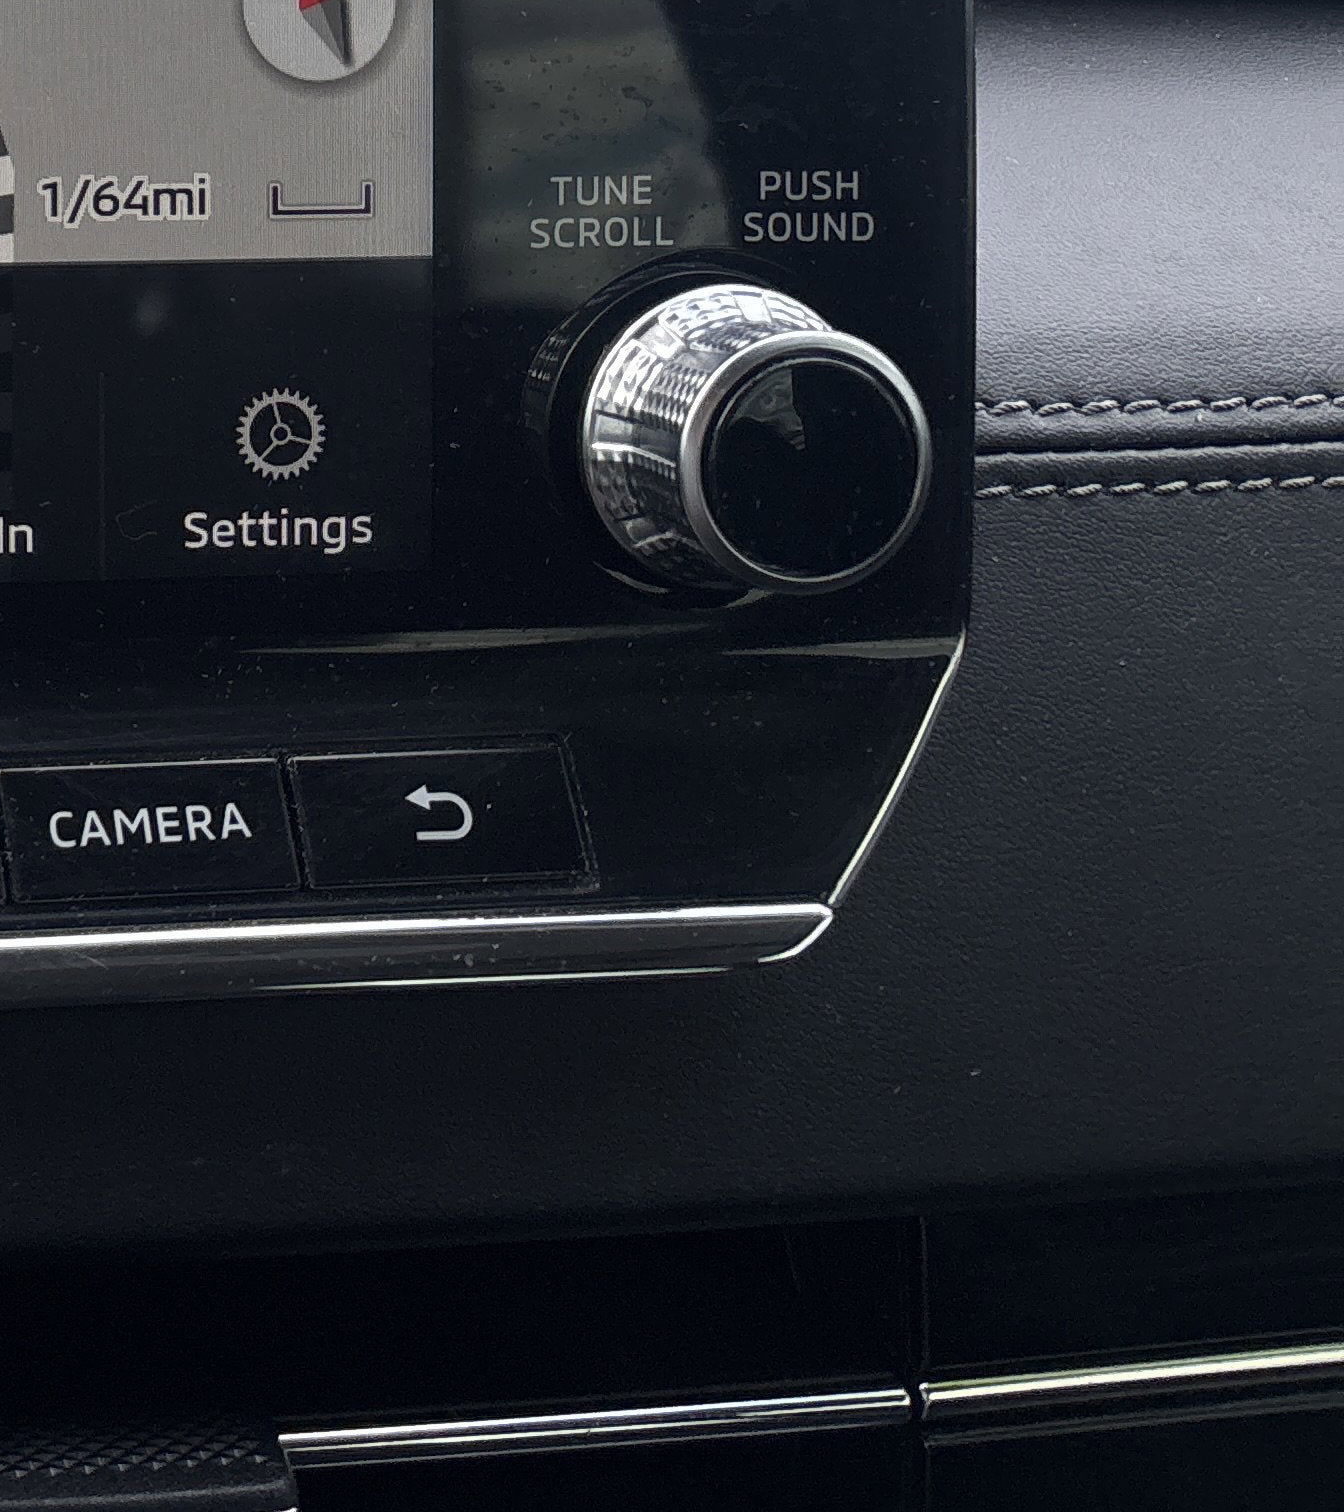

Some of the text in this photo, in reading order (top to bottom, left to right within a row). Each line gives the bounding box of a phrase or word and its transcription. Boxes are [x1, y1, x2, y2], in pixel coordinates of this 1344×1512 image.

[40, 176, 208, 224] 1/64mi
[549, 174, 654, 207] TUNE
[758, 170, 860, 202] PUSH
[529, 215, 674, 249] SCROLL
[742, 212, 875, 243] SOUND
[183, 508, 374, 555] Settings
[48, 802, 253, 849] CAMERA
